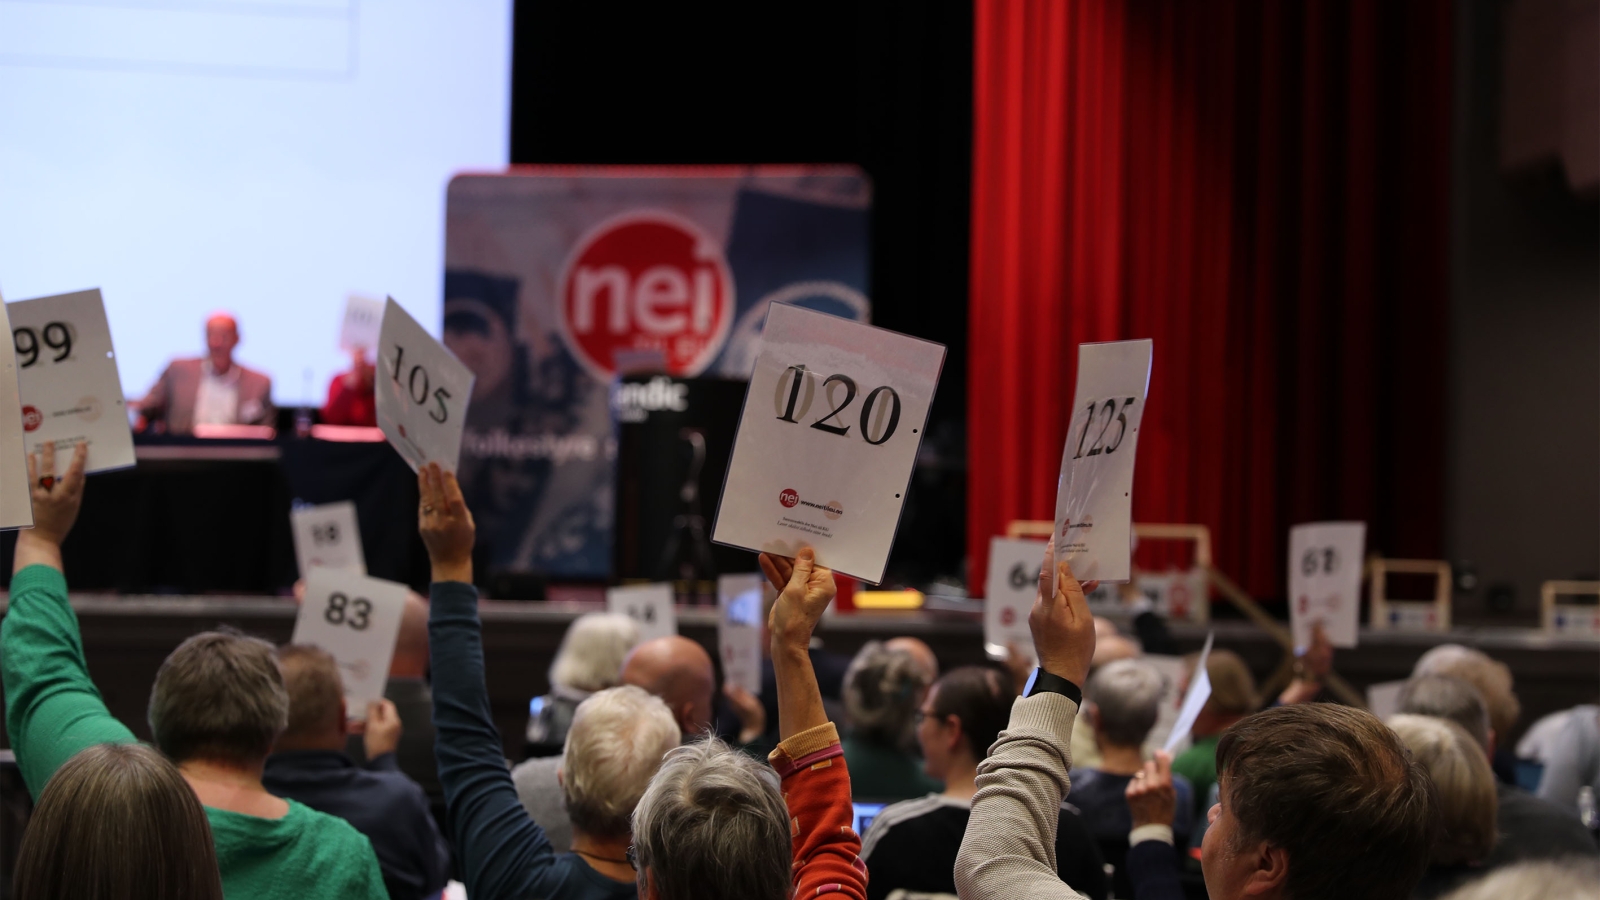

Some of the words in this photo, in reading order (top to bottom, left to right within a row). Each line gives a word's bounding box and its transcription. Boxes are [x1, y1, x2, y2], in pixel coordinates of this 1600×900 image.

[572, 237, 716, 334] nei
[13, 321, 73, 369] 99
[394, 343, 452, 424] 105
[775, 364, 902, 446] 120
[1072, 397, 1136, 460] 125
[324, 591, 373, 632] 83
